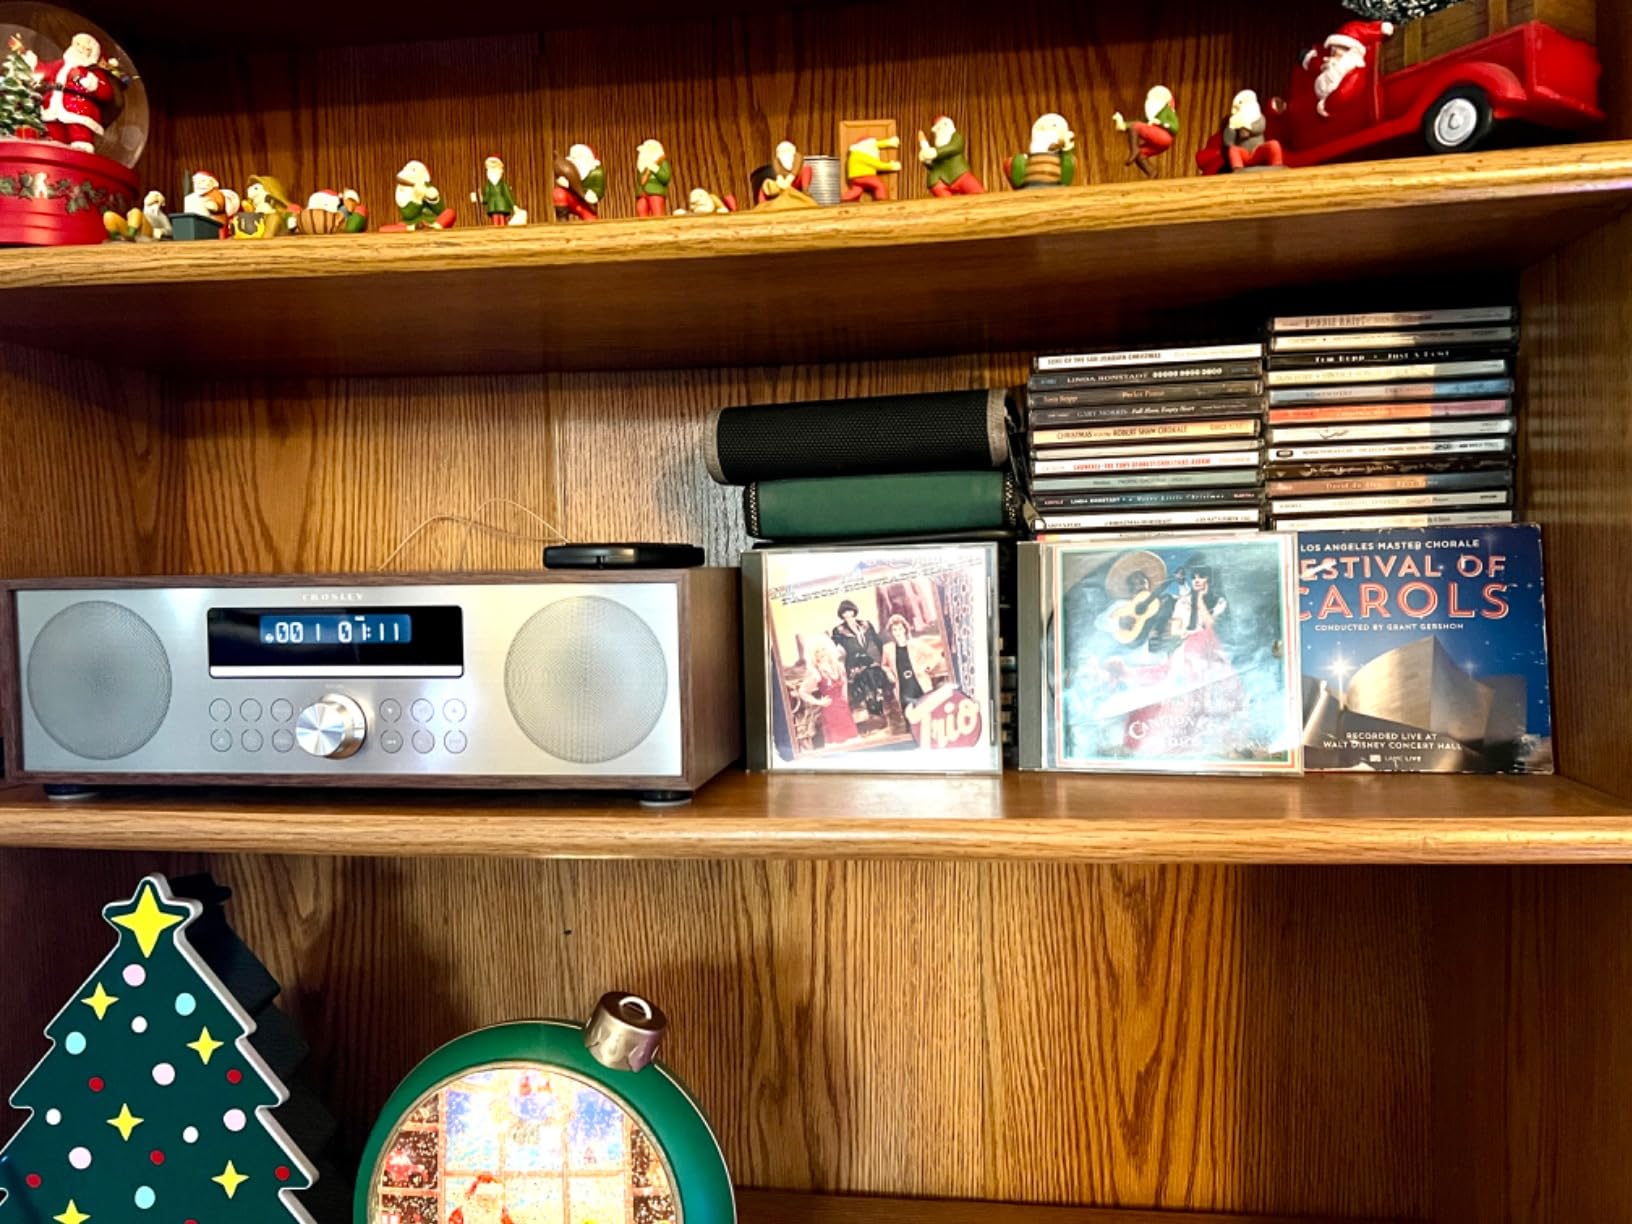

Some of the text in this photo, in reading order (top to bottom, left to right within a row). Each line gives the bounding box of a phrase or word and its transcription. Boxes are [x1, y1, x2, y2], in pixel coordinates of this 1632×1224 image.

[1300, 539, 1480, 552] LOS ANGELES MASTER CHORALE
[1300, 554, 1507, 581] ESTIVAL OF
[302, 592, 364, 602] CROSLEY
[1314, 622, 1465, 632] CONDUCTED BY GRANT GERSHON
[905, 683, 982, 750] Trio
[1346, 731, 1438, 741] RECORDED LIVE AT
[1323, 741, 1463, 750] WALT DISNEY CONCERT HALL
